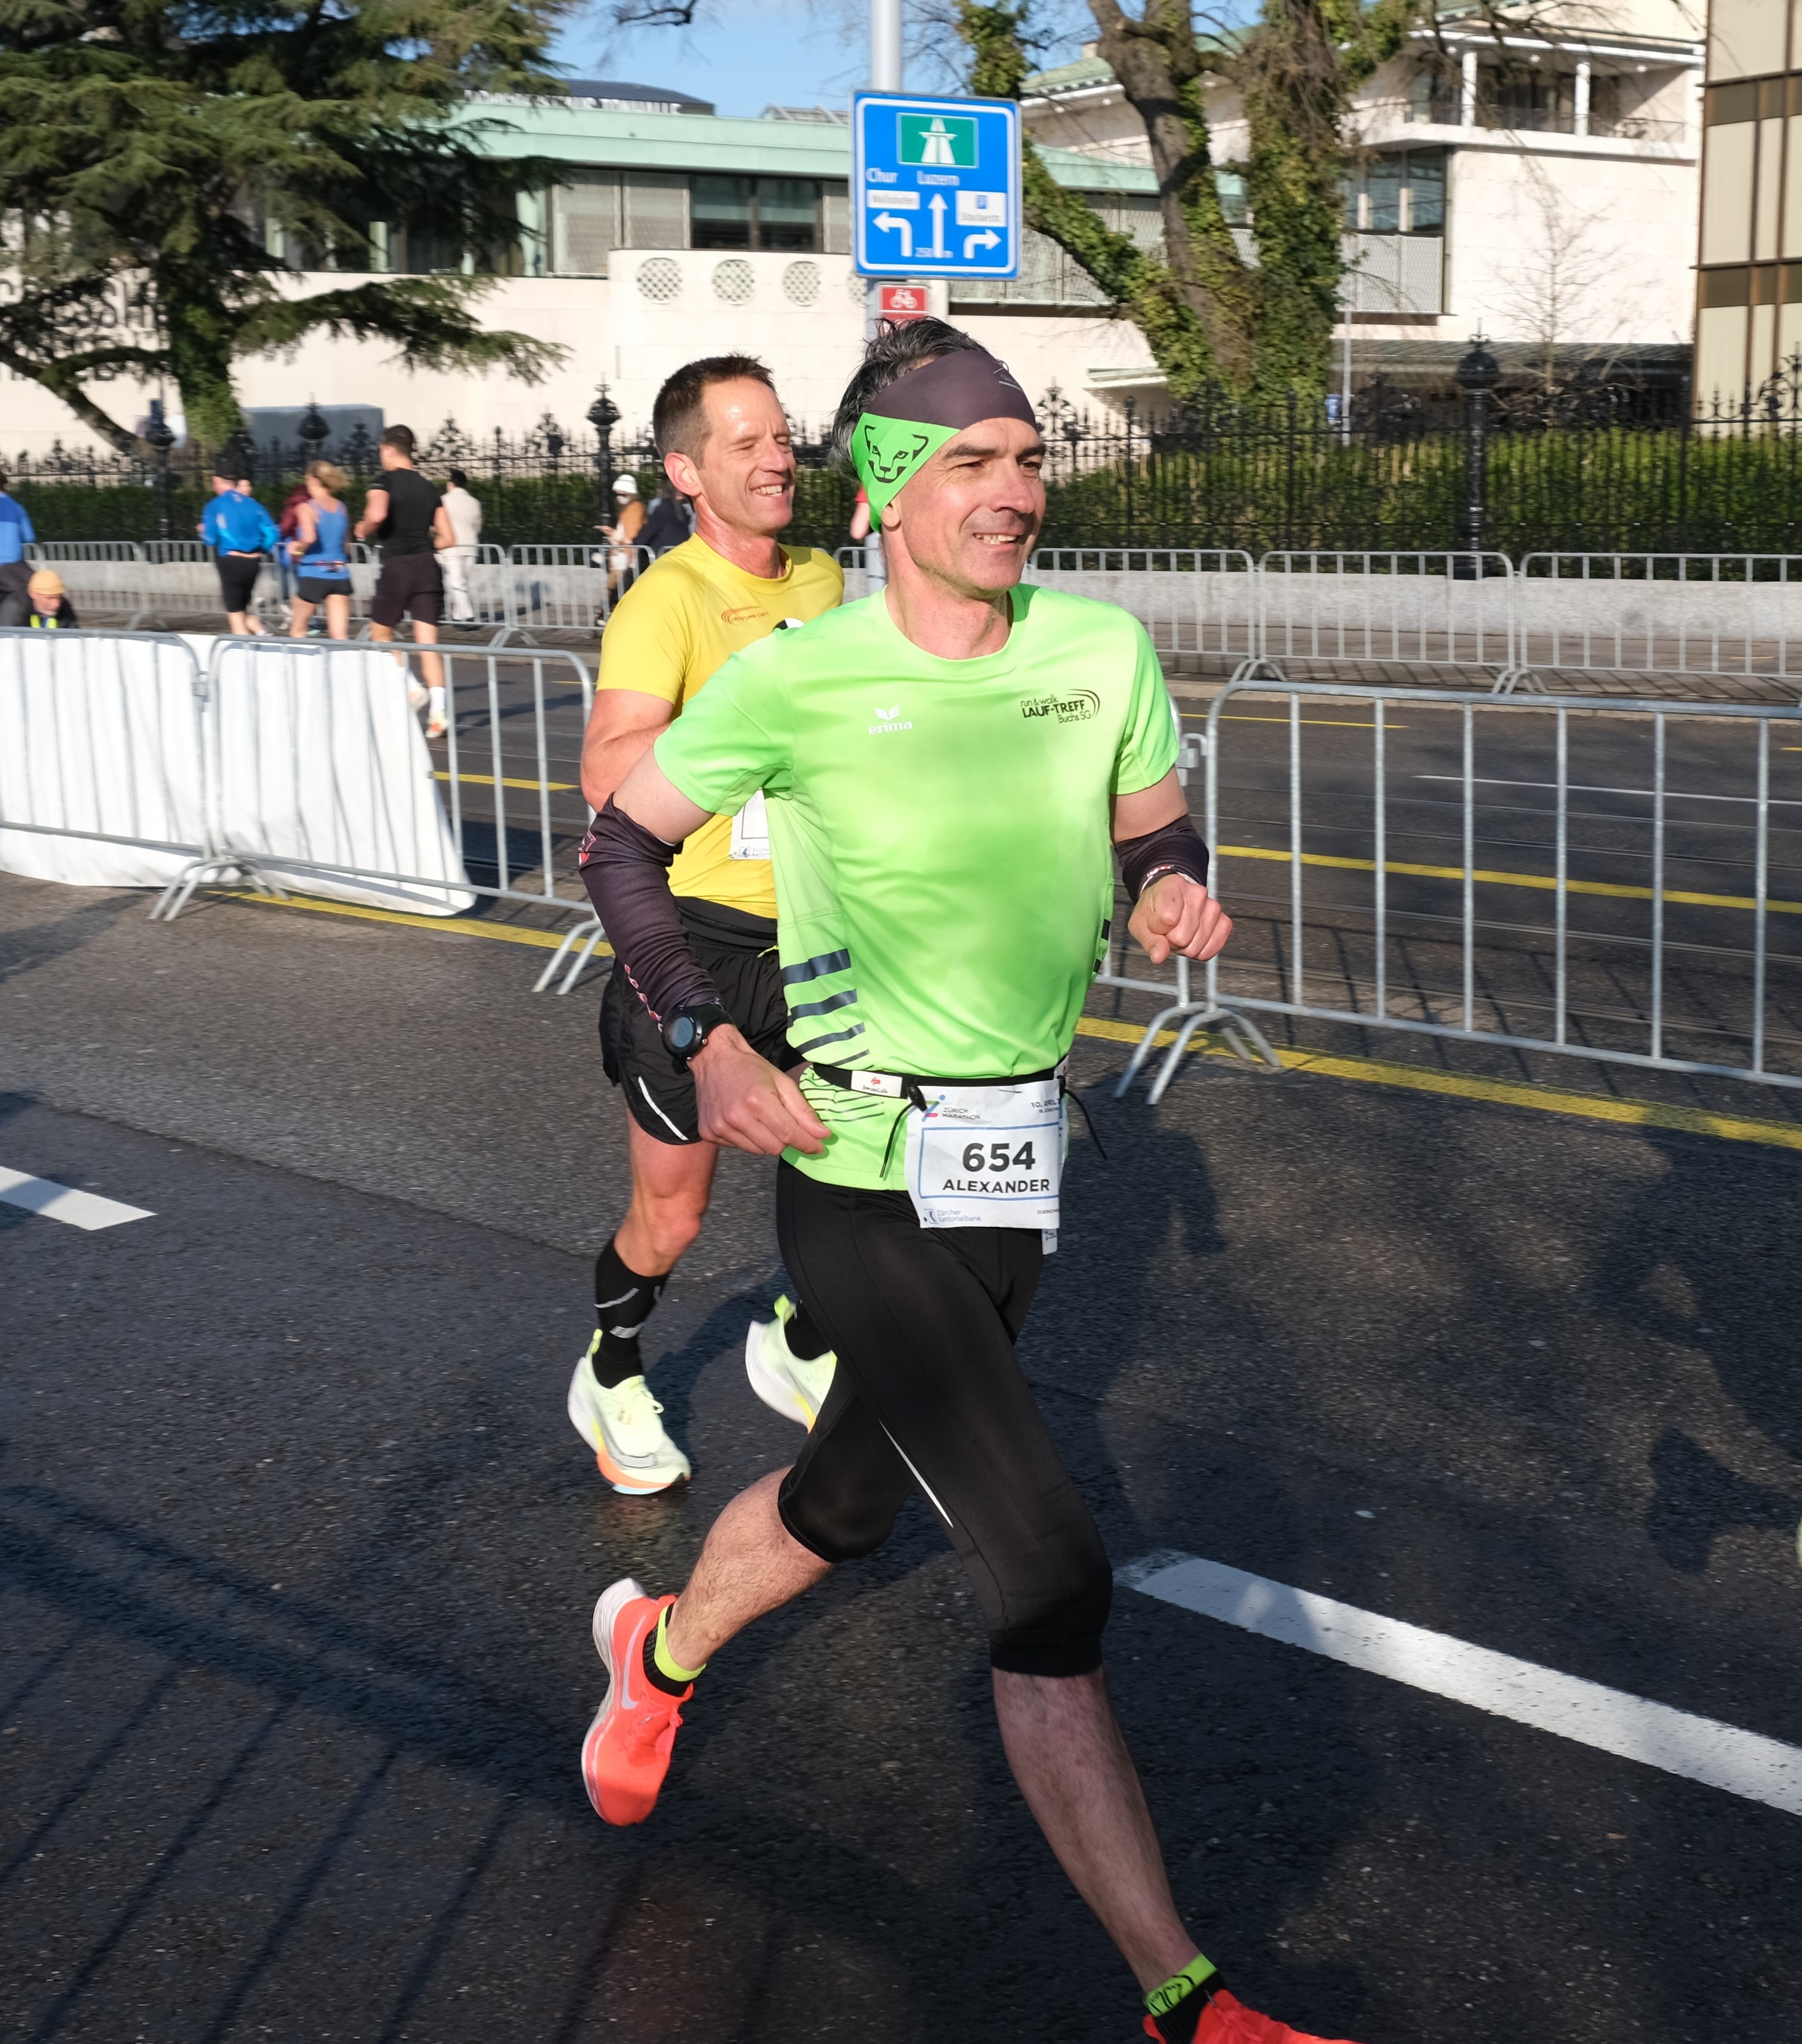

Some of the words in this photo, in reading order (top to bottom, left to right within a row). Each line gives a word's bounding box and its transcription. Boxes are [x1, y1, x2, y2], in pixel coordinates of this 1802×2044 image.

[866, 168, 898, 183] Chur
[1039, 694, 1059, 705] walk
[1057, 712, 1080, 723] Buchs
[1079, 710, 1092, 720] SG
[868, 720, 912, 735] erima
[962, 1141, 1036, 1173] 654
[942, 1179, 1050, 1193] ALEXANDER
